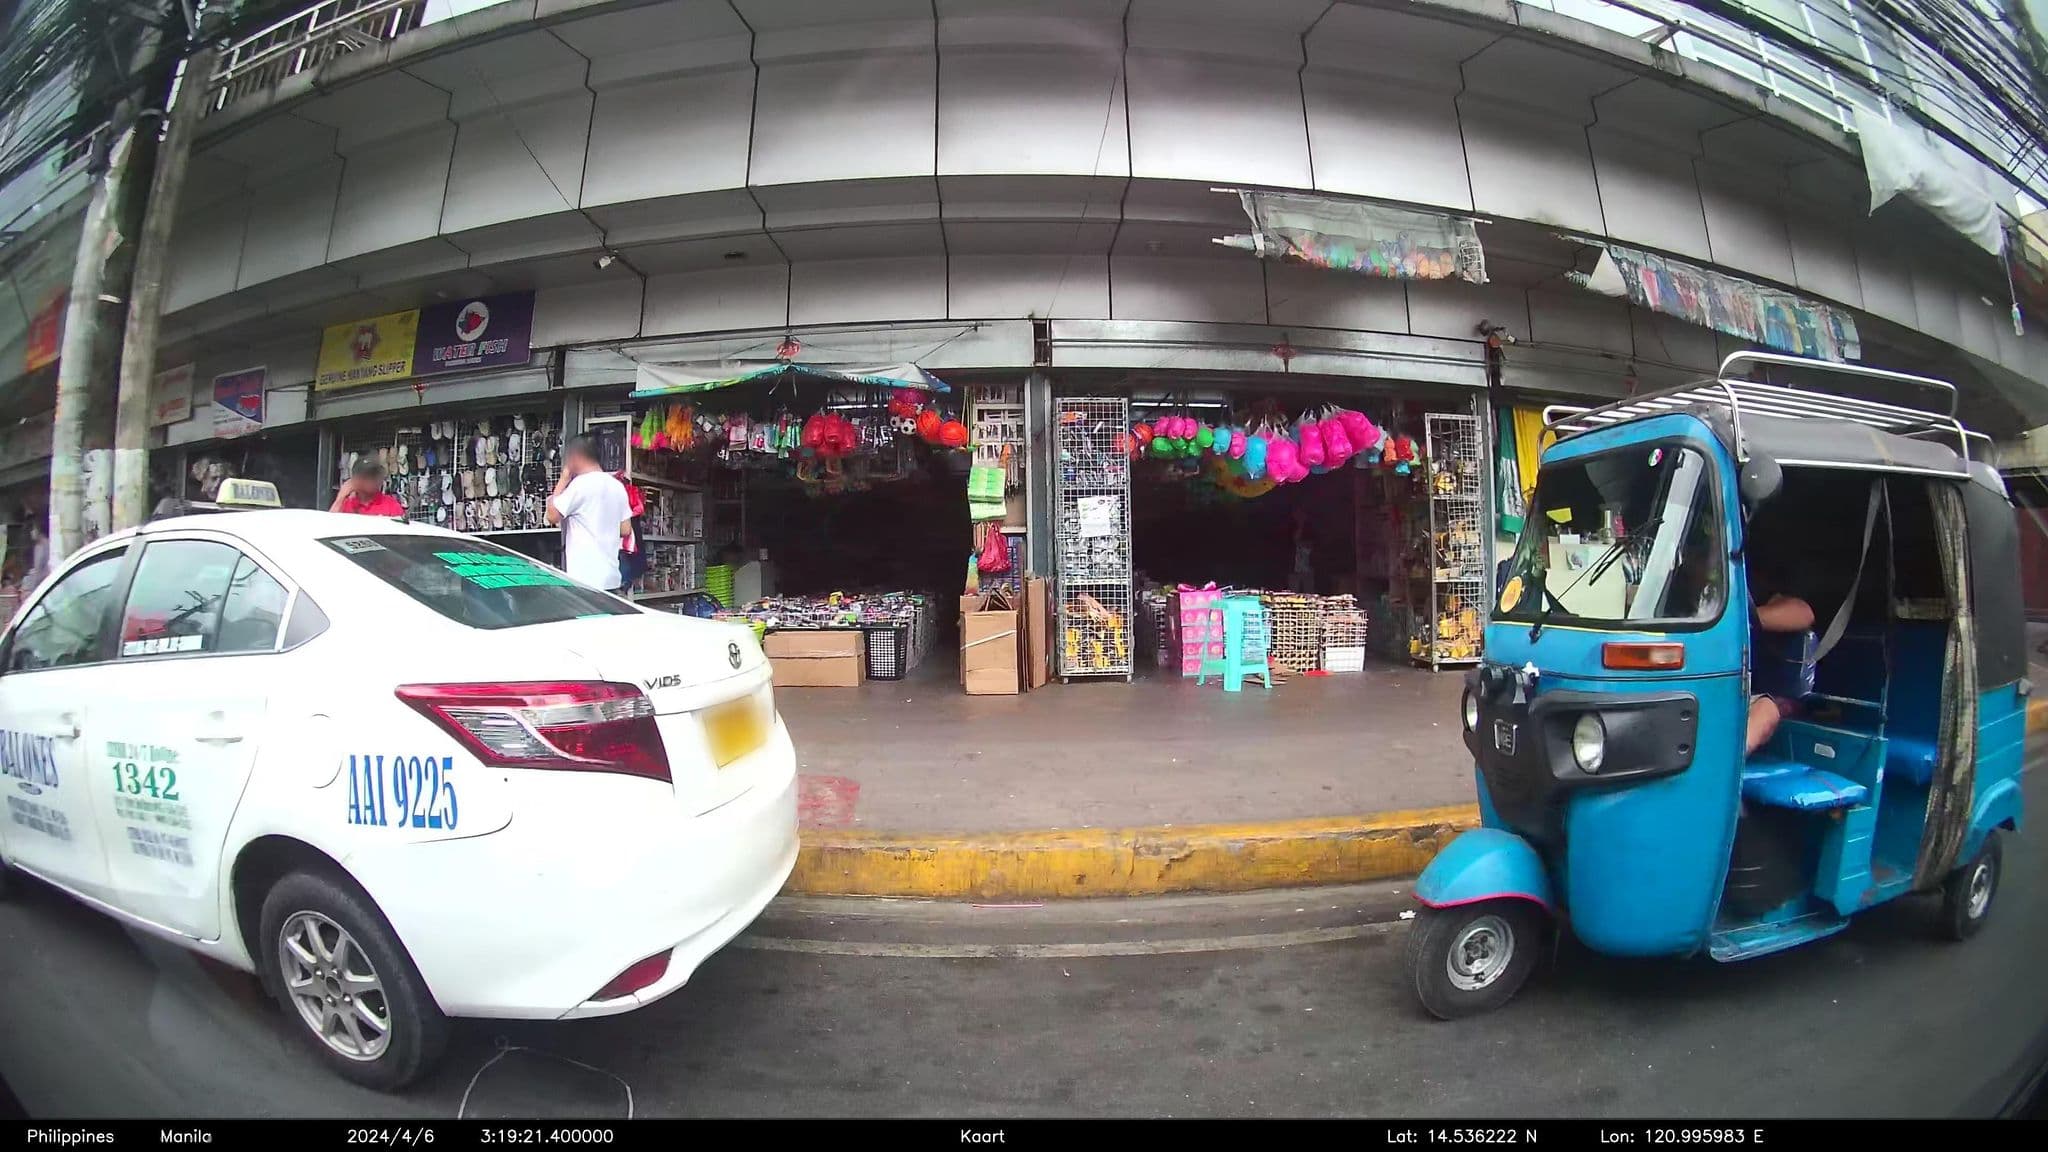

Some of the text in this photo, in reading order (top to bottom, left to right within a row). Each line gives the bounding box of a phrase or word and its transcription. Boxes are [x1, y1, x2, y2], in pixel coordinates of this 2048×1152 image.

[432, 343, 477, 362] WATER
[478, 338, 509, 356] FISH
[378, 360, 407, 376] SLIPPER
[112, 761, 180, 802] 1342
[348, 754, 458, 831] AAI 9225
